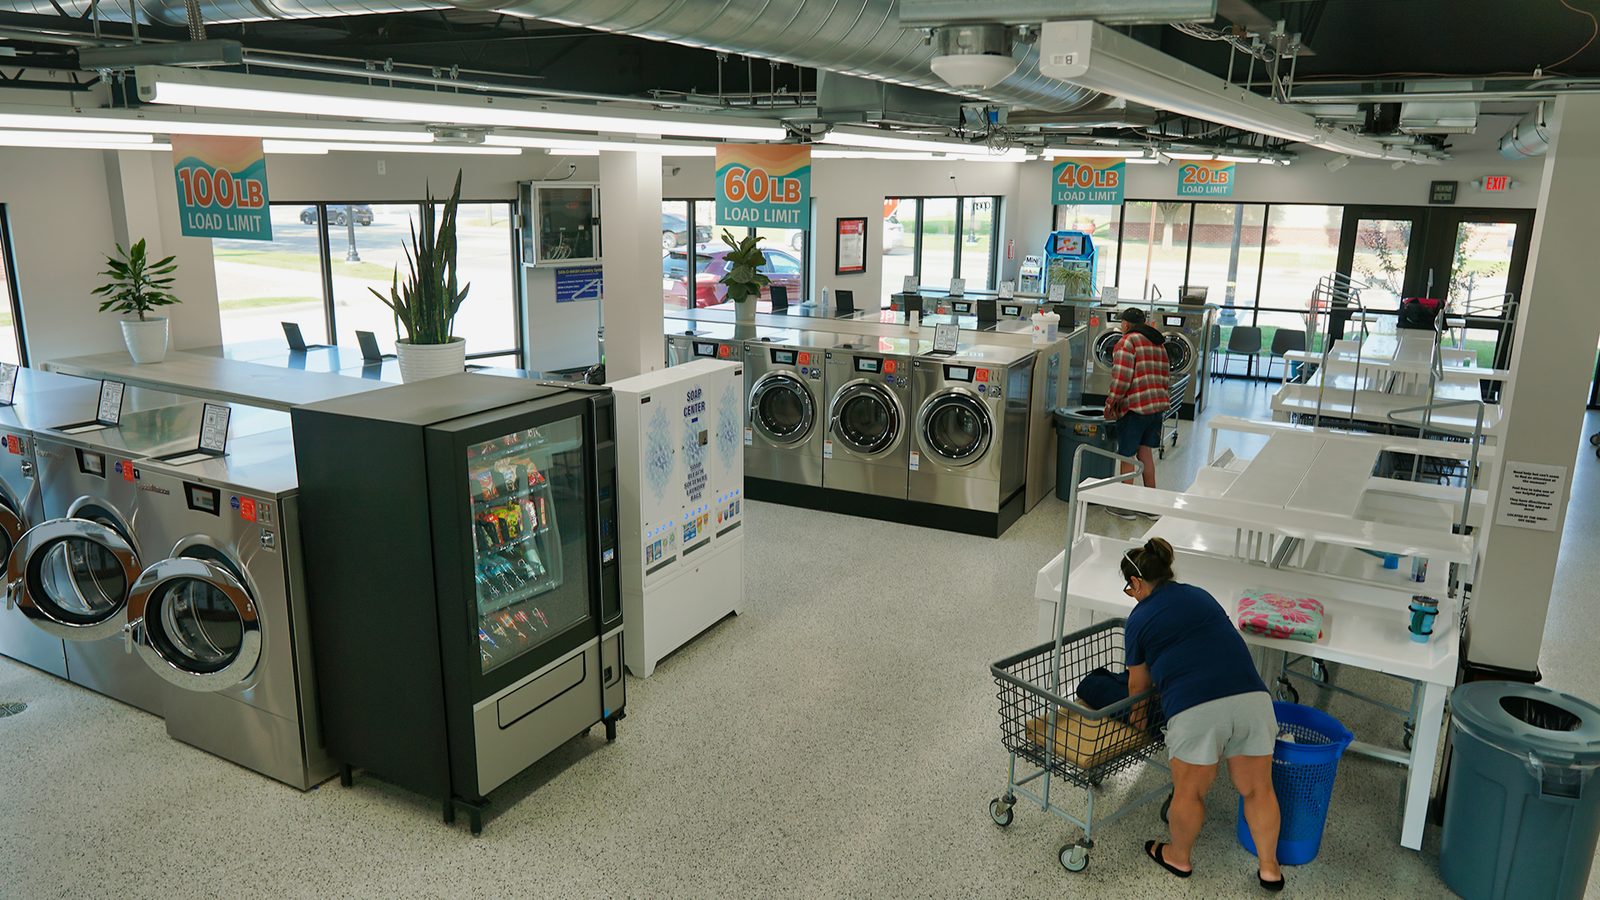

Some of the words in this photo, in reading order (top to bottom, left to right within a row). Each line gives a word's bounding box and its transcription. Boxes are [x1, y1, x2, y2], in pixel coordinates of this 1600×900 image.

[1057, 164, 1118, 188] 40LB
[1183, 166, 1228, 184] 20LB
[178, 167, 265, 209] 100LB
[724, 167, 801, 204] 60LB
[1182, 186, 1203, 195] LOAD
[1206, 186, 1227, 195] LIMIT
[1486, 176, 1507, 191] EXIT
[1058, 191, 1085, 201] LOAD
[1088, 192, 1117, 202] LIMIT
[188, 212, 222, 230] LOAD
[226, 214, 261, 232] LIMIT
[725, 208, 759, 222] LOAD
[764, 209, 800, 223] LIMIT
[687, 388, 702, 402] SOAP
[684, 401, 706, 417] CENTER
[684, 474, 707, 489] SOFTENERS
[688, 468, 704, 480] BLEACH
[686, 483, 705, 496] LAUNDRY
[690, 492, 702, 501] BAGS
